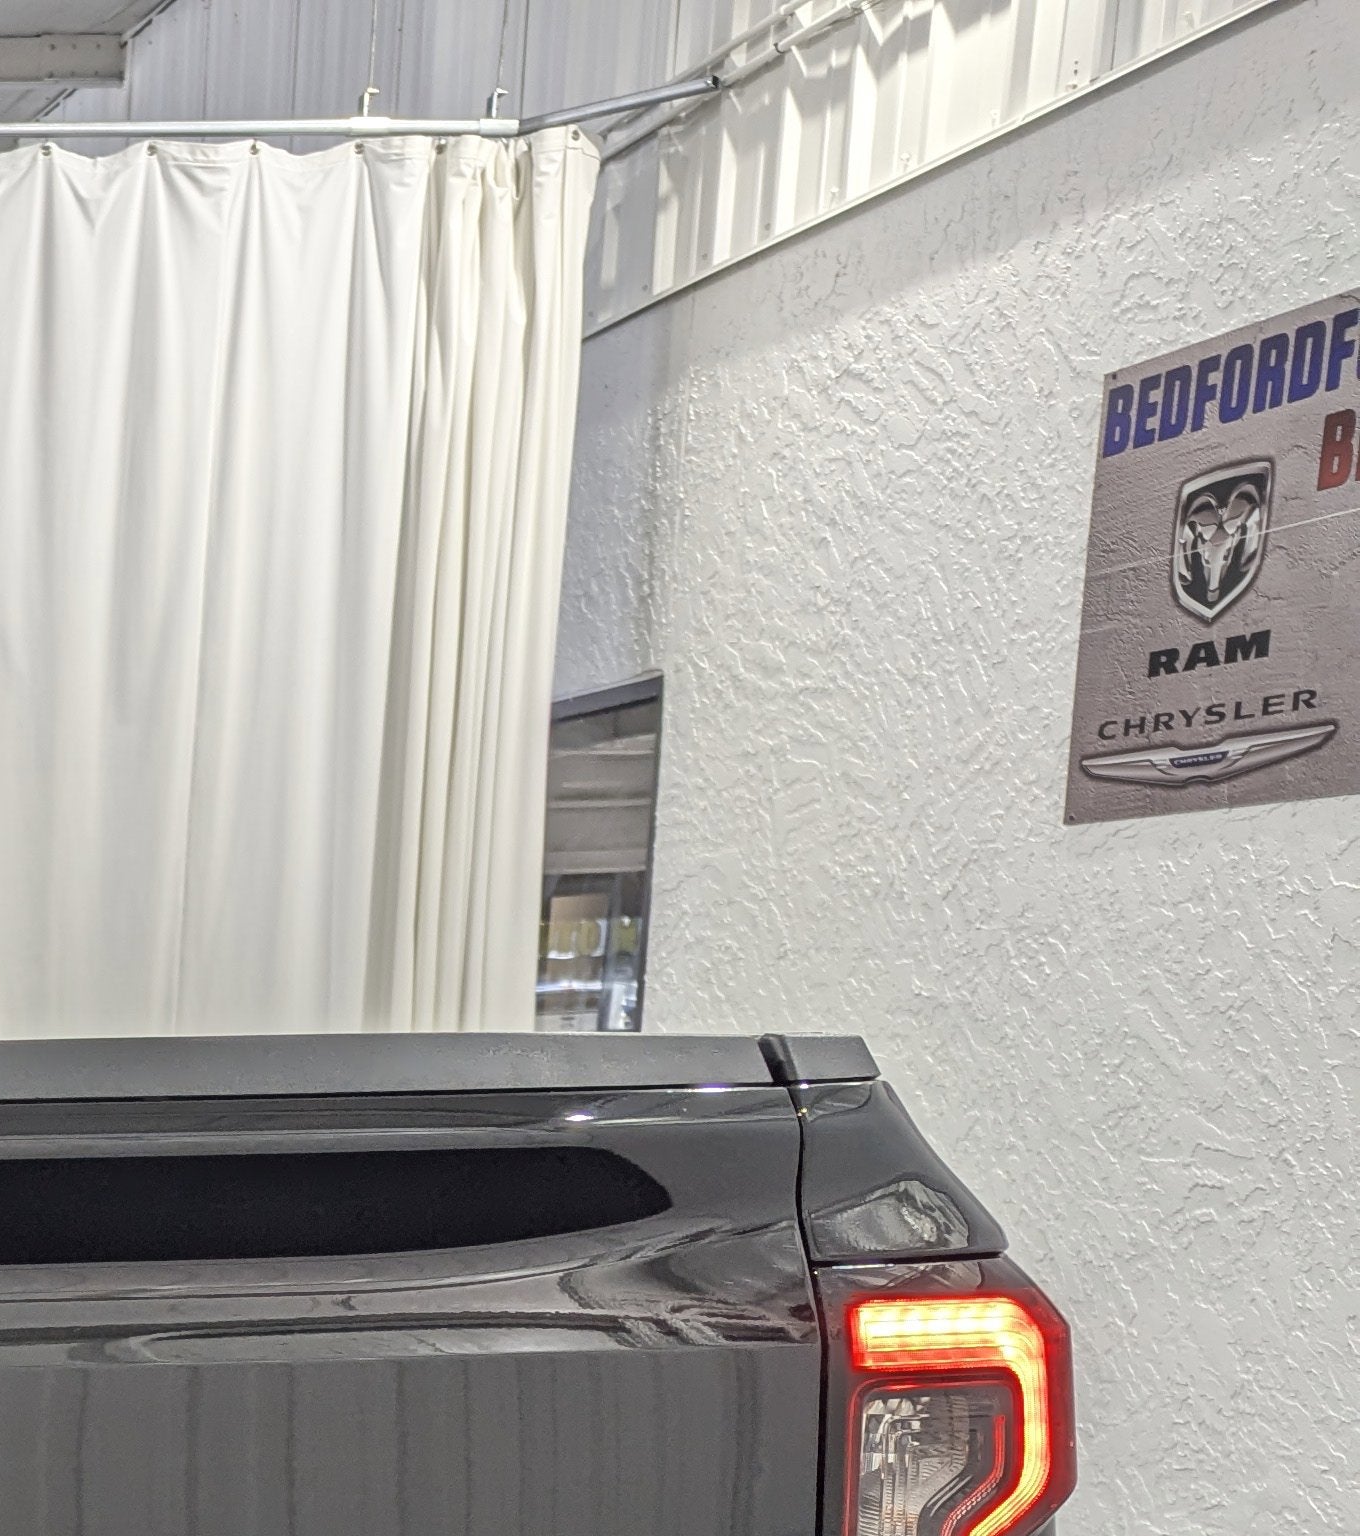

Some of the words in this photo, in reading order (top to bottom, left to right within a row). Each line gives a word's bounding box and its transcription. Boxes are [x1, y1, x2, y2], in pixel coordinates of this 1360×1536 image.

[1102, 308, 1360, 459] BEDFORDF
[1316, 408, 1360, 492] B
[1147, 629, 1272, 679] RAM
[1097, 689, 1318, 740] CHRYSLER
